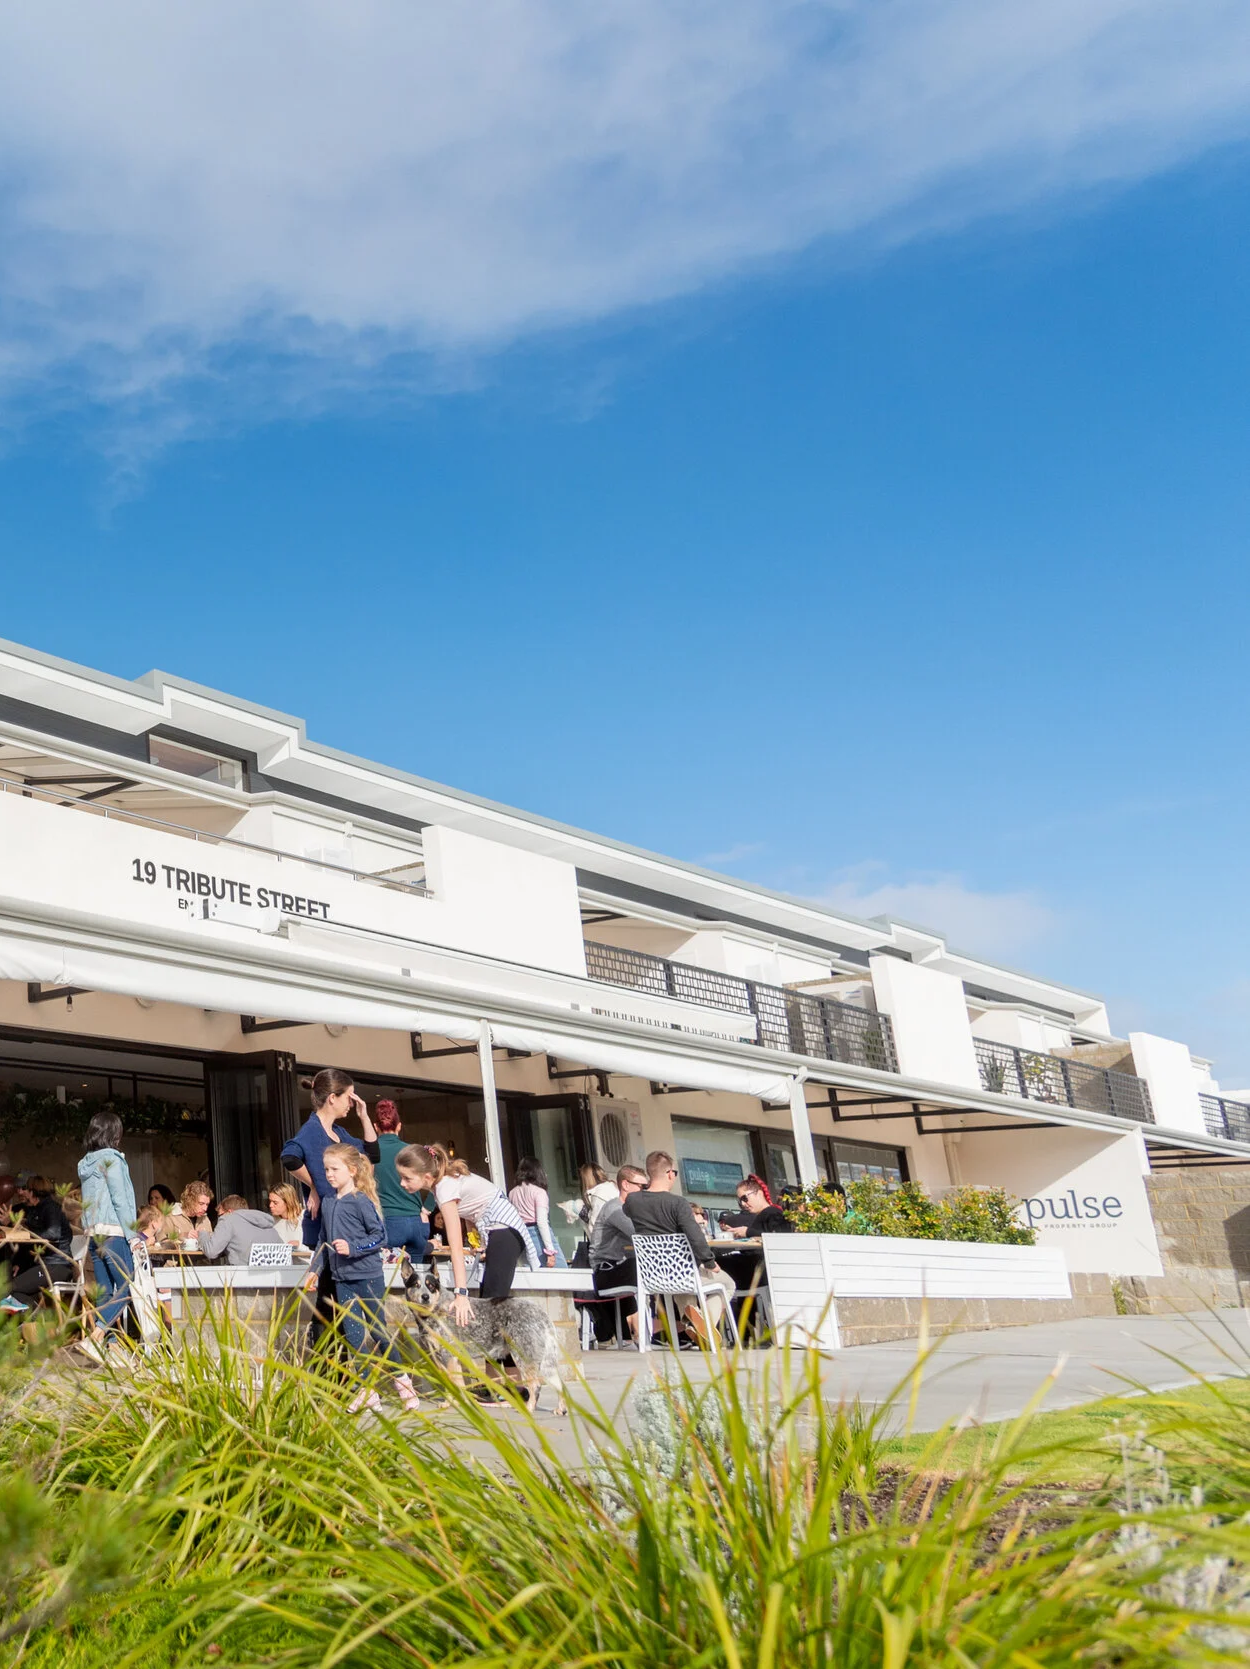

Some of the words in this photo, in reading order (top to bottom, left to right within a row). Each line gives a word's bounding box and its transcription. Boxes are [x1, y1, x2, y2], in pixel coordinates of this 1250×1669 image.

[132, 858, 157, 885] 19
[161, 864, 252, 906] TRIBUTE
[257, 887, 330, 919] STREET
[1022, 1190, 1123, 1228] pulse
